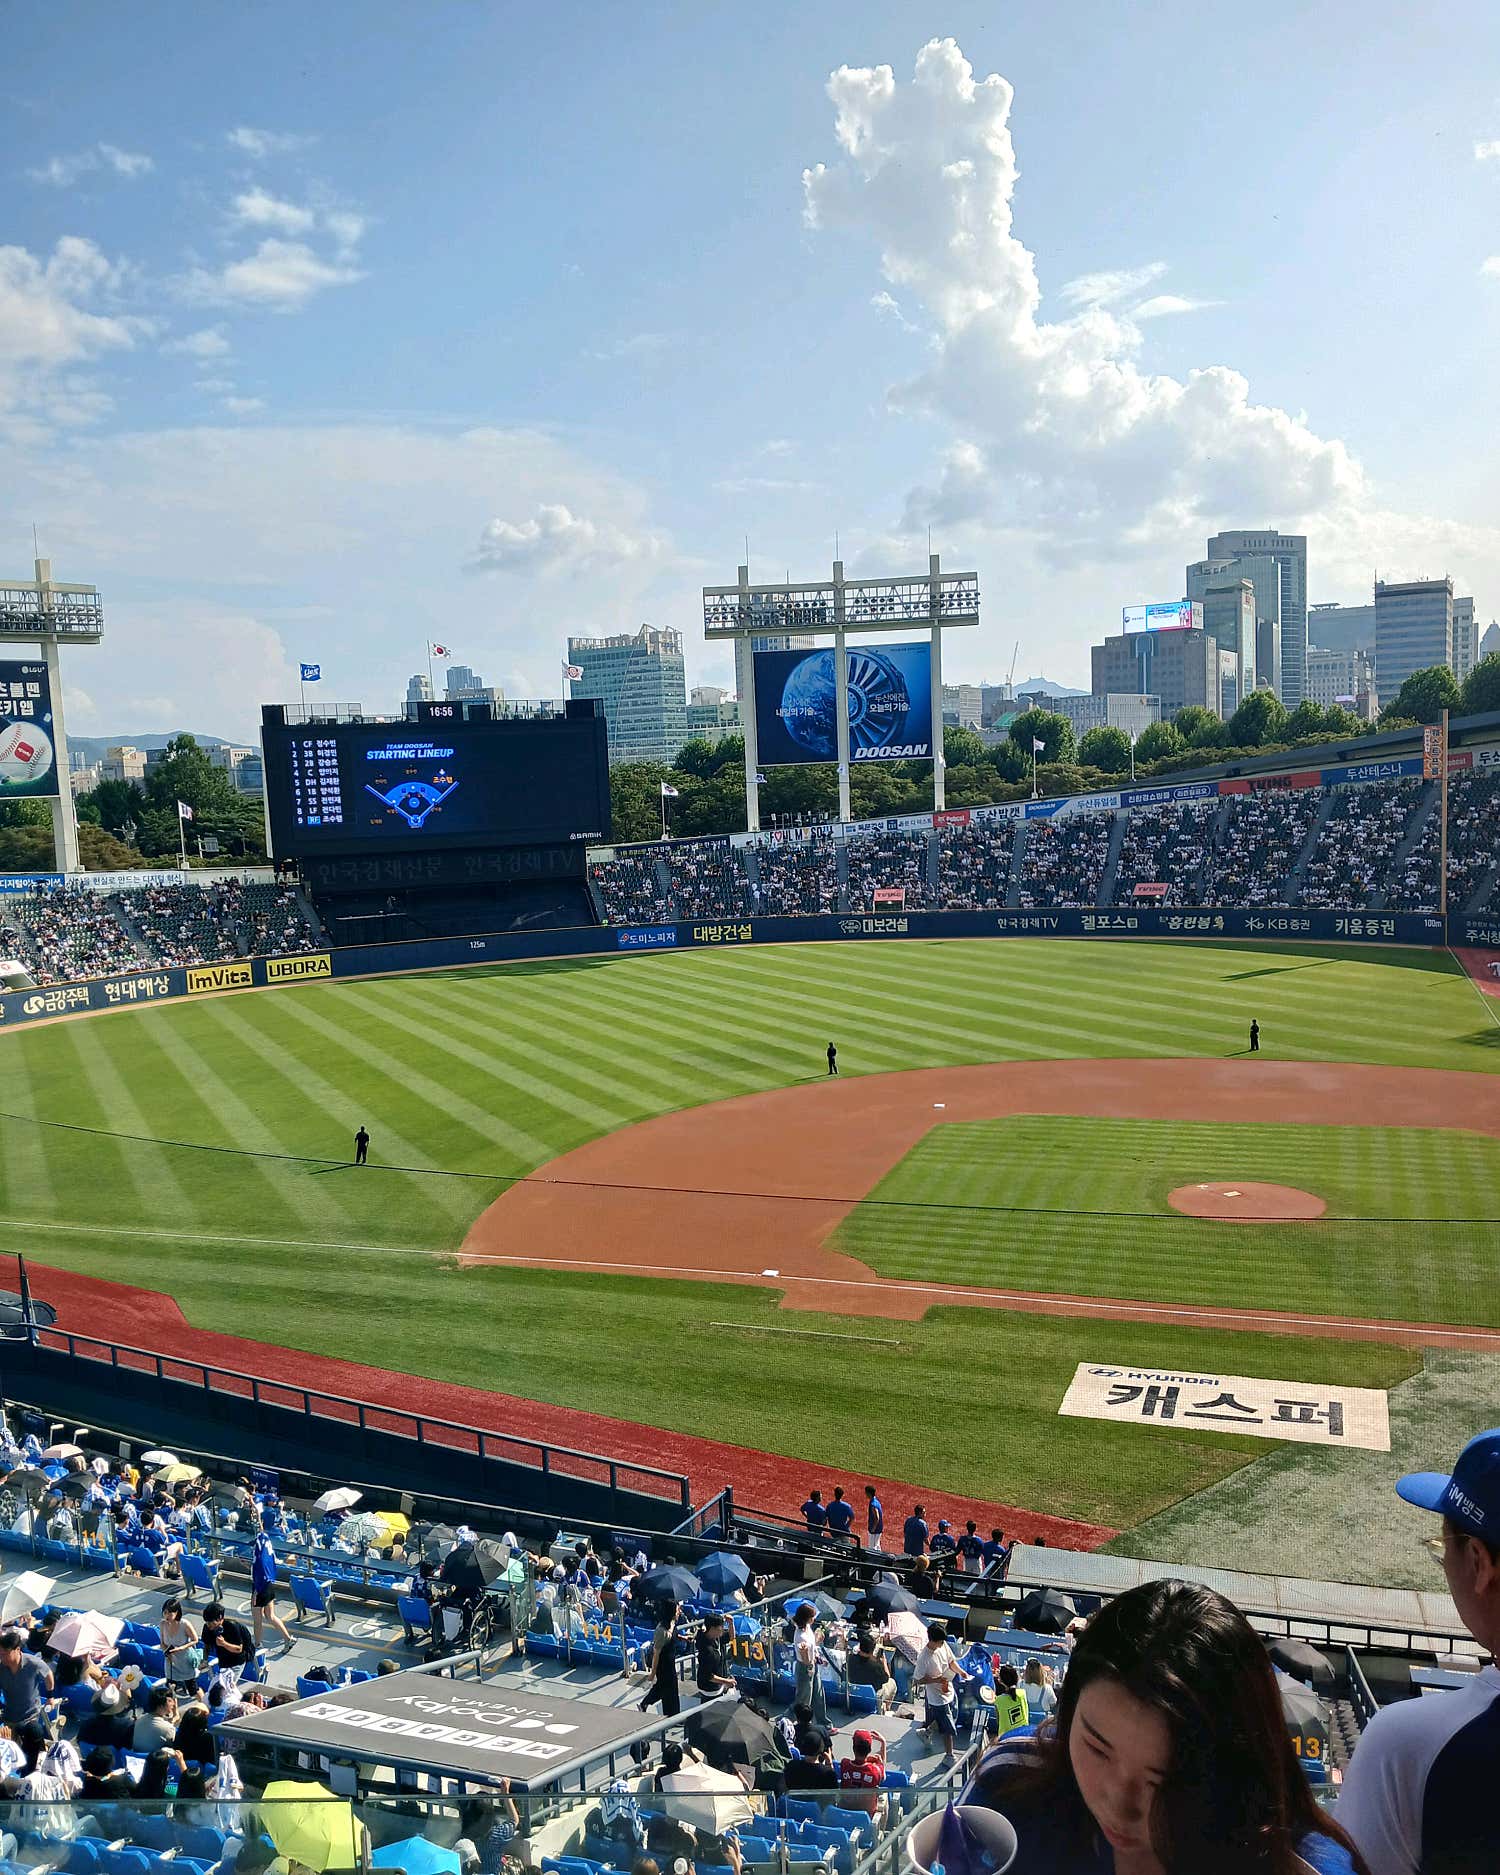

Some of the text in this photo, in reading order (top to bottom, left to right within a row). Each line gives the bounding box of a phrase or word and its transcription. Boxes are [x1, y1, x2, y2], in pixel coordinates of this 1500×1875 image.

[0, 700, 17, 716] 키
[430, 706, 453, 717] 16:56
[303, 740, 313, 748] CF
[855, 743, 928, 759] DOOSAN
[367, 748, 455, 760] STARTING LINEUP
[307, 769, 313, 777] C
[1346, 763, 1402, 781] 두산테스나
[305, 778, 317, 786] DH
[862, 918, 908, 933] 대보건설
[1335, 917, 1395, 936] 키움증권
[1424, 918, 1442, 928] 100m
[629, 931, 676, 945] 도미노피자
[693, 923, 752, 942] 대방건설
[469, 939, 486, 950] 125m
[268, 959, 330, 978] UBORA
[104, 975, 170, 1002] 현대해상
[45, 986, 90, 1012] 금강주택
[1128, 1371, 1221, 1387] HYUNDAI
[1105, 1383, 1344, 1437] 캐스퍼
[730, 1638, 765, 1661] 113
[385, 1694, 517, 1726] Dolby
[450, 1696, 553, 1719] CINEMA
[303, 1704, 561, 1757] MEGABOX
